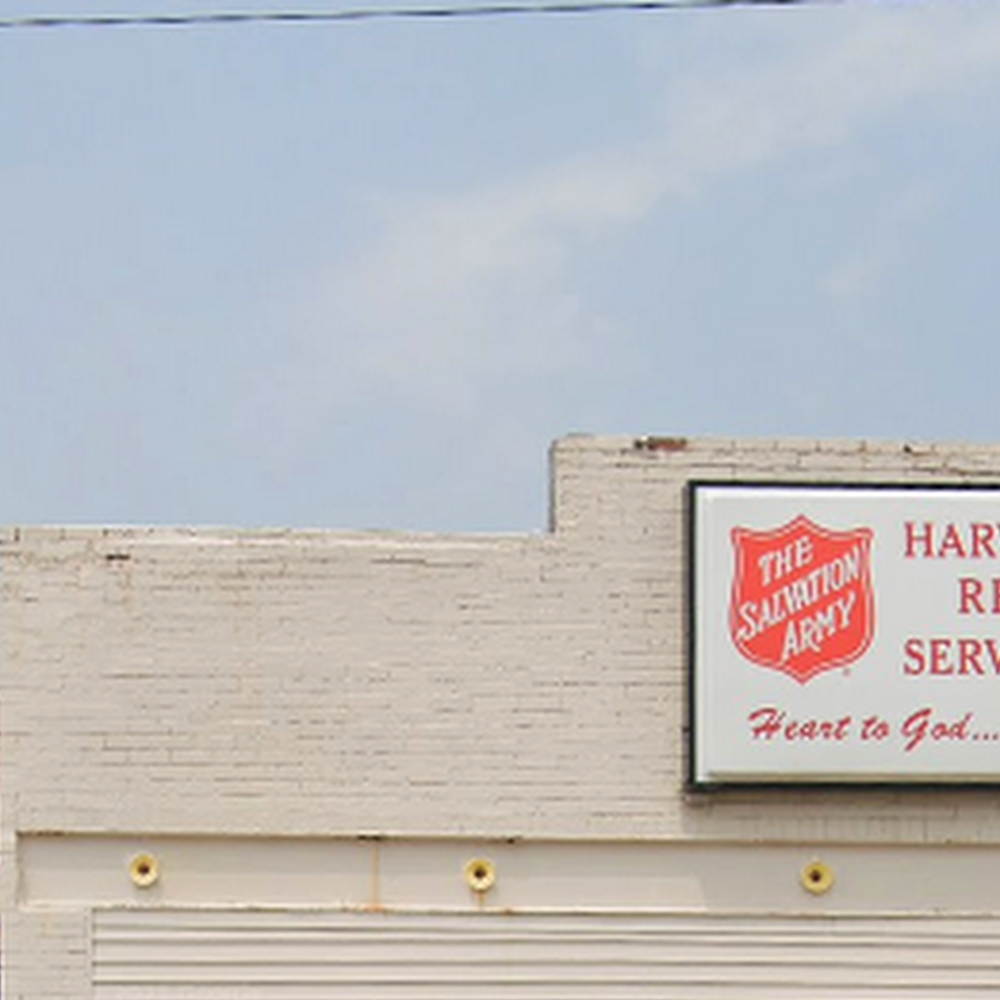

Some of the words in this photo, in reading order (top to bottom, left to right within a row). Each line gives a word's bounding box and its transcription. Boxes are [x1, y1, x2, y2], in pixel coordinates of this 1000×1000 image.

[736, 543, 862, 642] SALVATION
[757, 535, 815, 588] THE
[778, 590, 857, 667] ARMY
[748, 707, 853, 742] Heart
[860, 716, 891, 742] to
